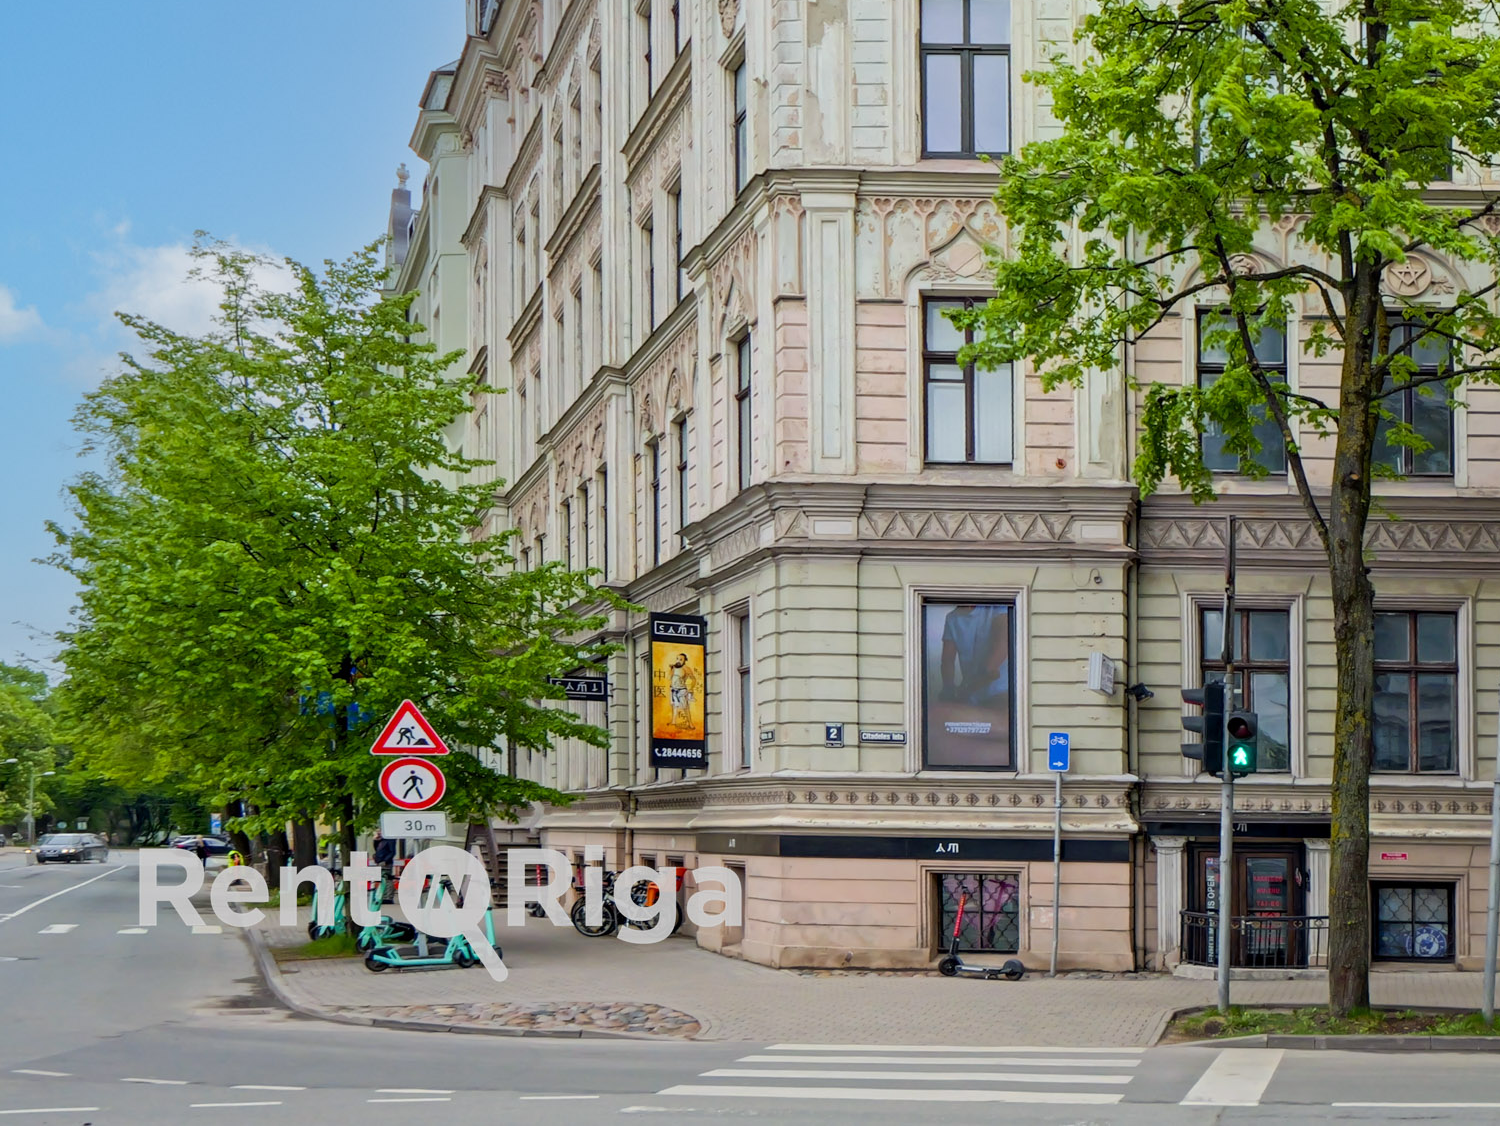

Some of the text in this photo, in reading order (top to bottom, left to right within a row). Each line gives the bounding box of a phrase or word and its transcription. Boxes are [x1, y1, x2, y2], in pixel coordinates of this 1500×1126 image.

[829, 728, 838, 739] 2
[861, 732, 891, 741] Citadeles
[404, 820, 423, 831] 30
[1207, 875, 1215, 899] OPEN
[1207, 899, 1215, 909] IS
